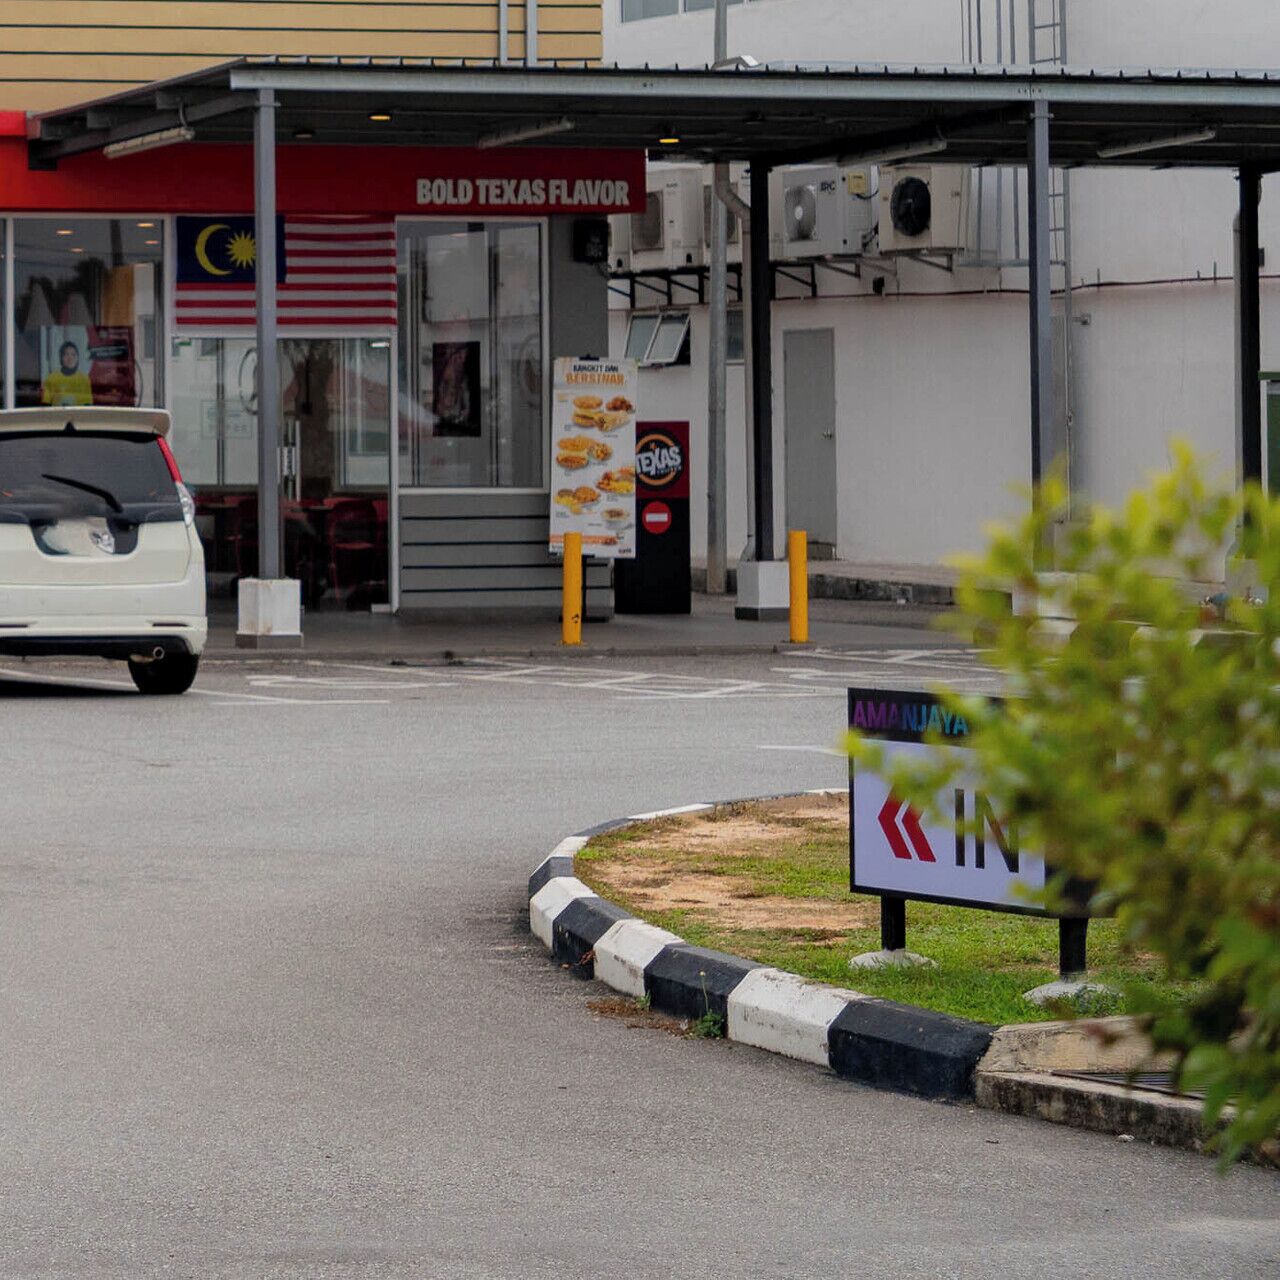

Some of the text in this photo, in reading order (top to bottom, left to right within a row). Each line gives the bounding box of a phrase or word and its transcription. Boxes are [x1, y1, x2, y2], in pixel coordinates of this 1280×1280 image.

[416, 178, 630, 206] BOLD TEXAS FLAVOR
[636, 446, 682, 476] TEXAS
[954, 788, 1020, 874] IN
